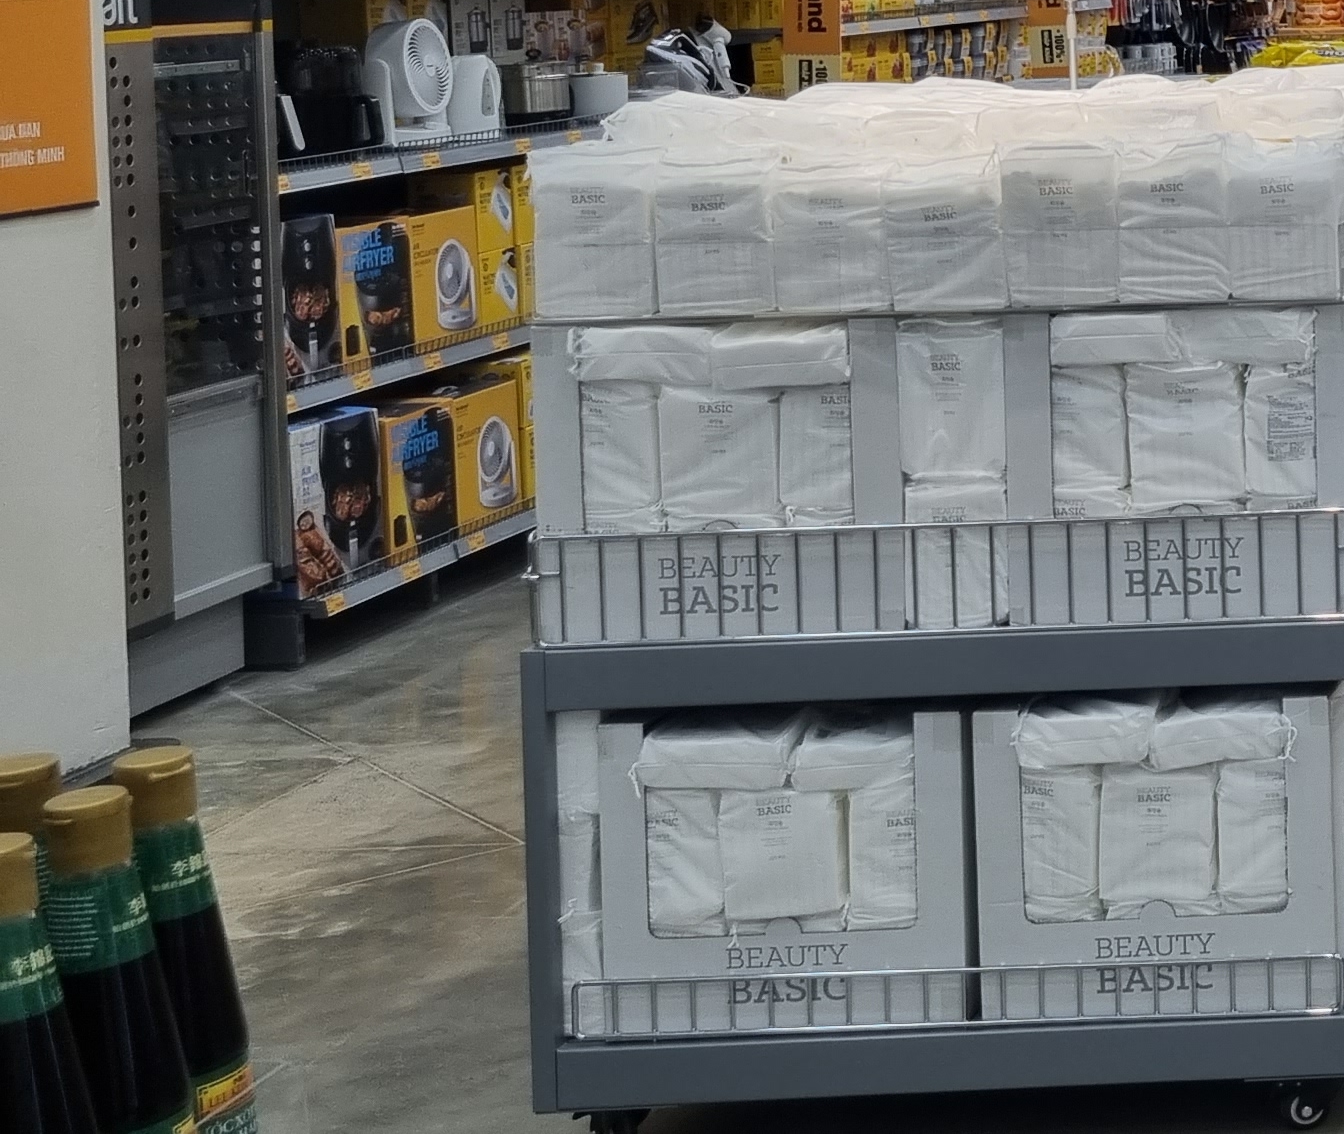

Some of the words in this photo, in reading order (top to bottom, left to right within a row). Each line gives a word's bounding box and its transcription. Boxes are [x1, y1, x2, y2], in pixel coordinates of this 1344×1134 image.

[657, 553, 781, 581] BEAUTY
[659, 582, 779, 616] BASIC
[1094, 931, 1215, 960] BEAUTY
[1096, 962, 1214, 994] BASIC
